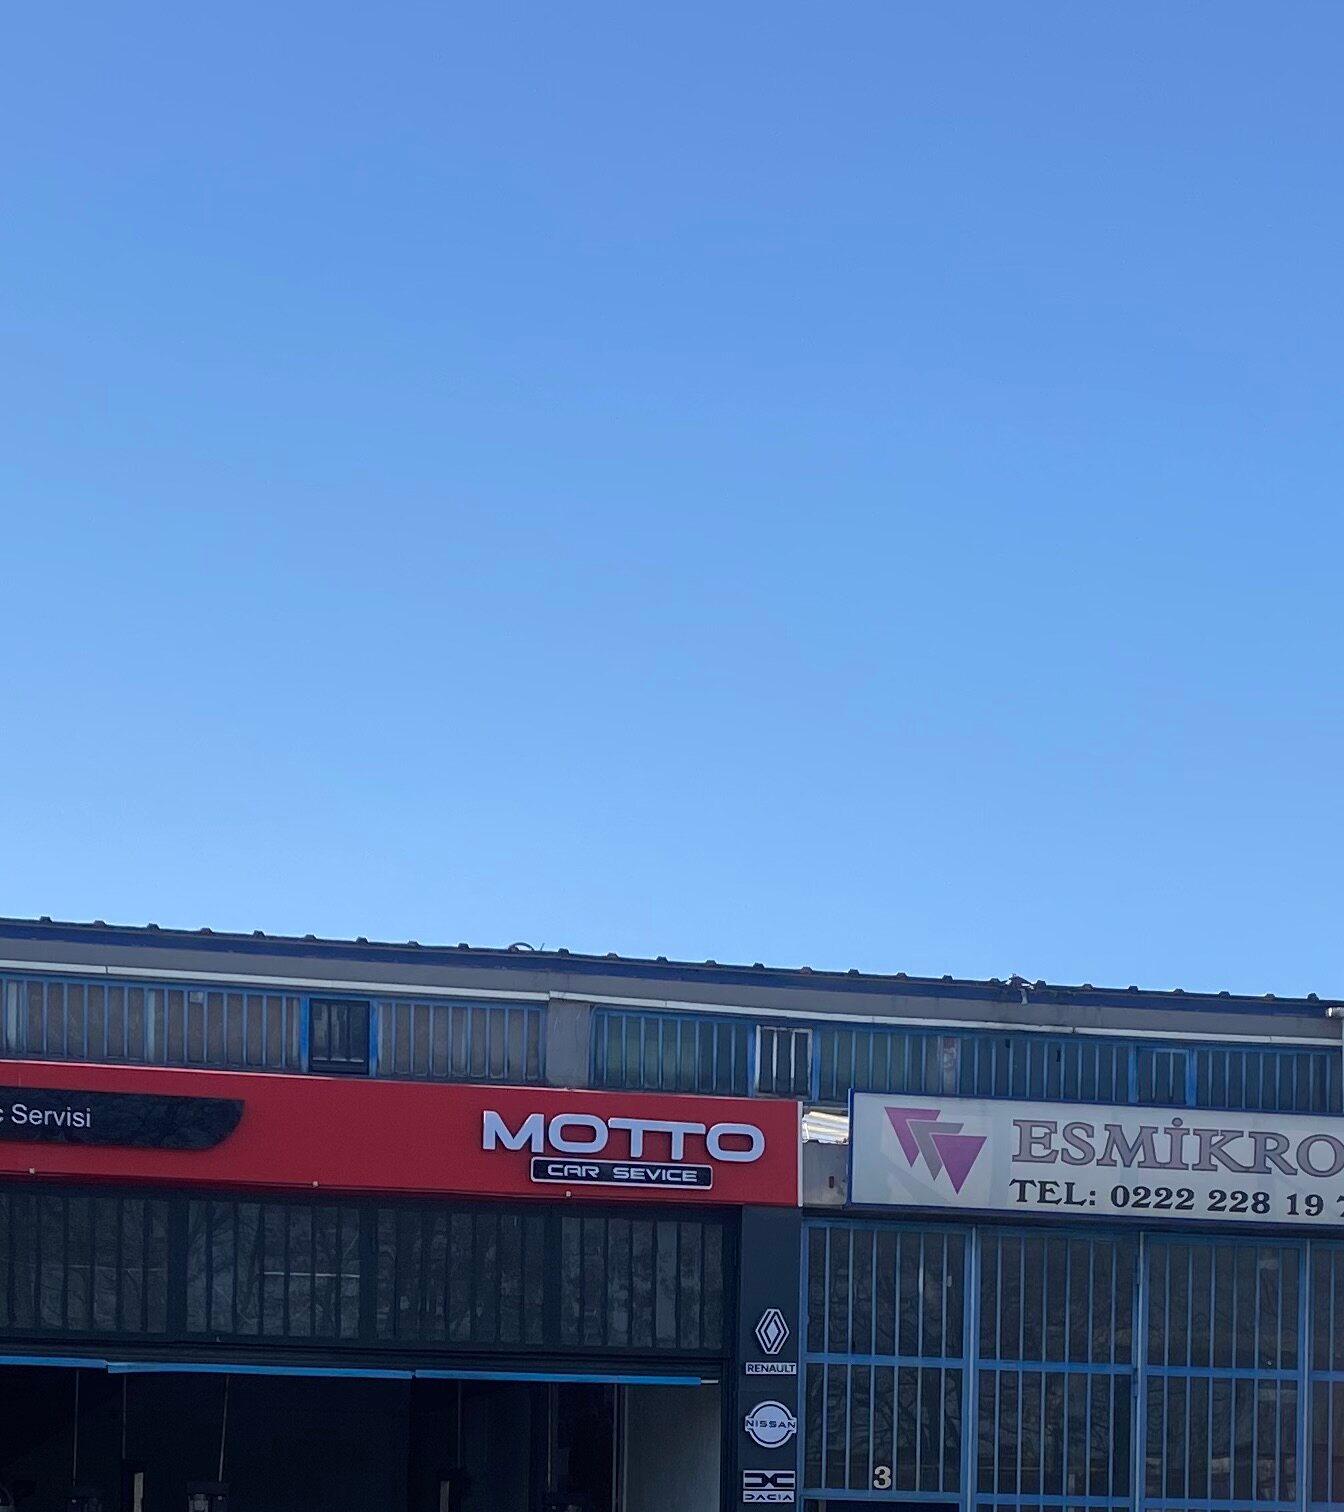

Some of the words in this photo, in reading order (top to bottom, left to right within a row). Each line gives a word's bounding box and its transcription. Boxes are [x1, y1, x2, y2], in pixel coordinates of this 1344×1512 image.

[11, 1103, 91, 1128] Servisi
[482, 1110, 765, 1163] MOTTO
[547, 1165, 599, 1178] CAR
[613, 1167, 698, 1183] SEVICE
[1009, 1178, 1096, 1206] TEL:
[1110, 1185, 1195, 1211] 0222
[1207, 1188, 1270, 1215] 228
[1286, 1192, 1324, 1217] 19
[747, 1364, 796, 1373] RENAULT
[745, 1420, 796, 1428] NISSAN
[873, 1465, 892, 1489] 3
[744, 1493, 792, 1501] DACIA
